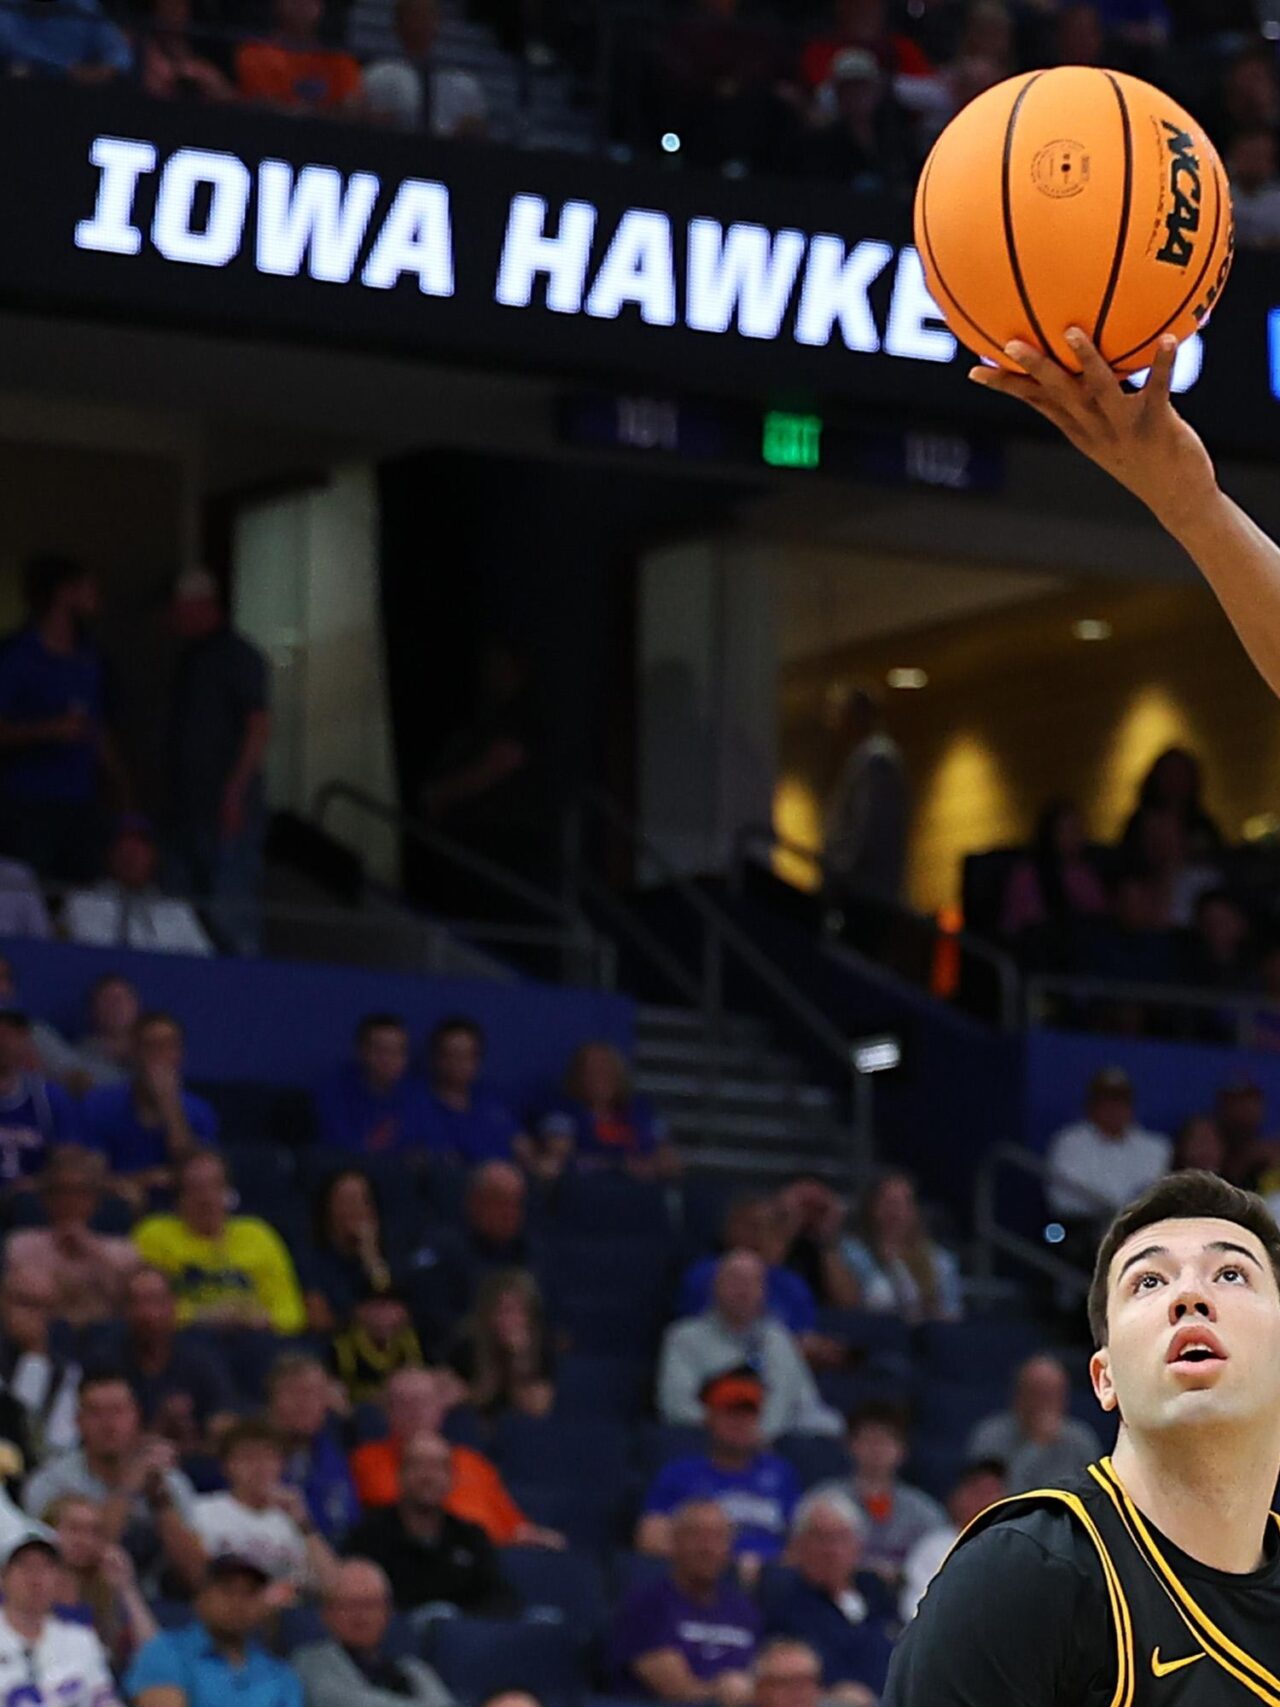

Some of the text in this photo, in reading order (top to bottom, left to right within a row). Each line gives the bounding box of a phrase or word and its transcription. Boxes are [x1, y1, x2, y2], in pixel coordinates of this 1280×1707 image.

[74, 134, 456, 298] IOWA
[495, 192, 1204, 394] HAWKE
[1155, 119, 1202, 268] NCAA
